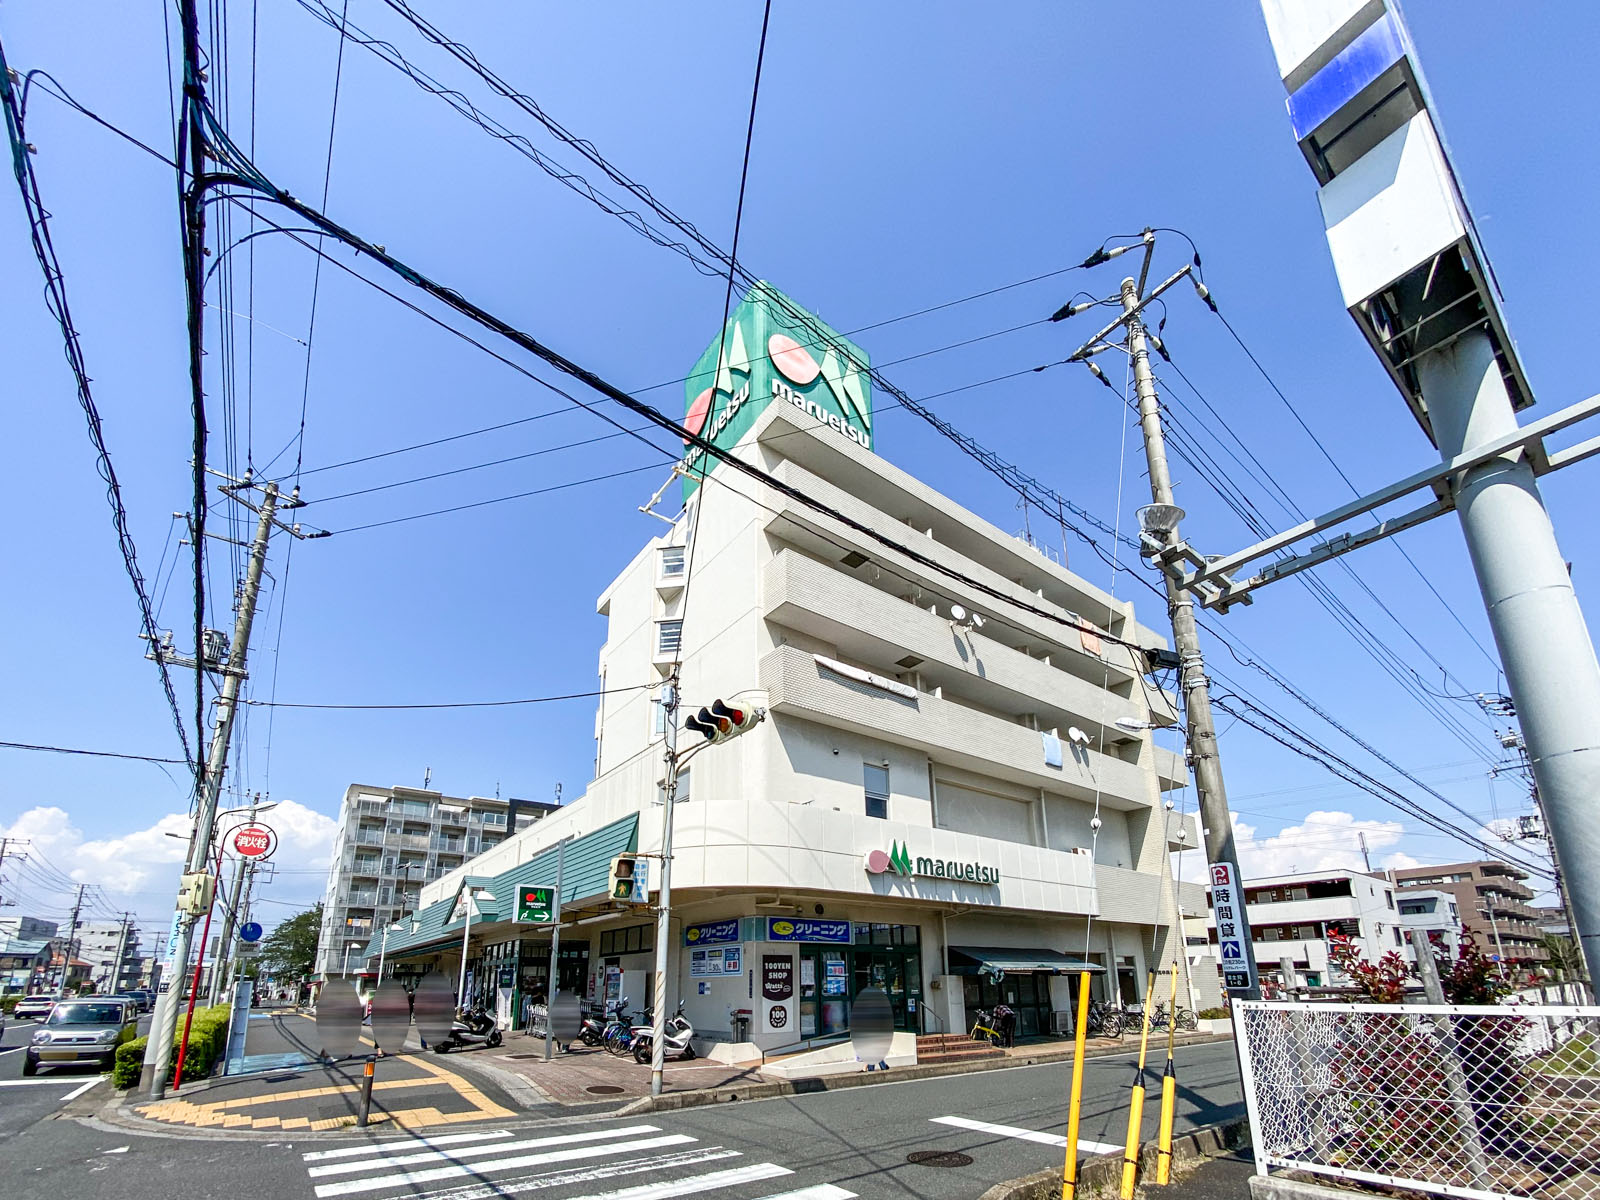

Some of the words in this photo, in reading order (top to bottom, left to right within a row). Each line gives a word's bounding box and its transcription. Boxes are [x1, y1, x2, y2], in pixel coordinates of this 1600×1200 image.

[772, 378, 870, 449] maruetsu
[236, 834, 268, 849] 消火栓
[916, 856, 1000, 884] maruetsu
[1215, 889, 1236, 938] 時間貸
[700, 922, 737, 938] クリーニング
[796, 923, 847, 936] クリーニング
[764, 962, 791, 970] 100YEN
[771, 1010, 785, 1018] 100
